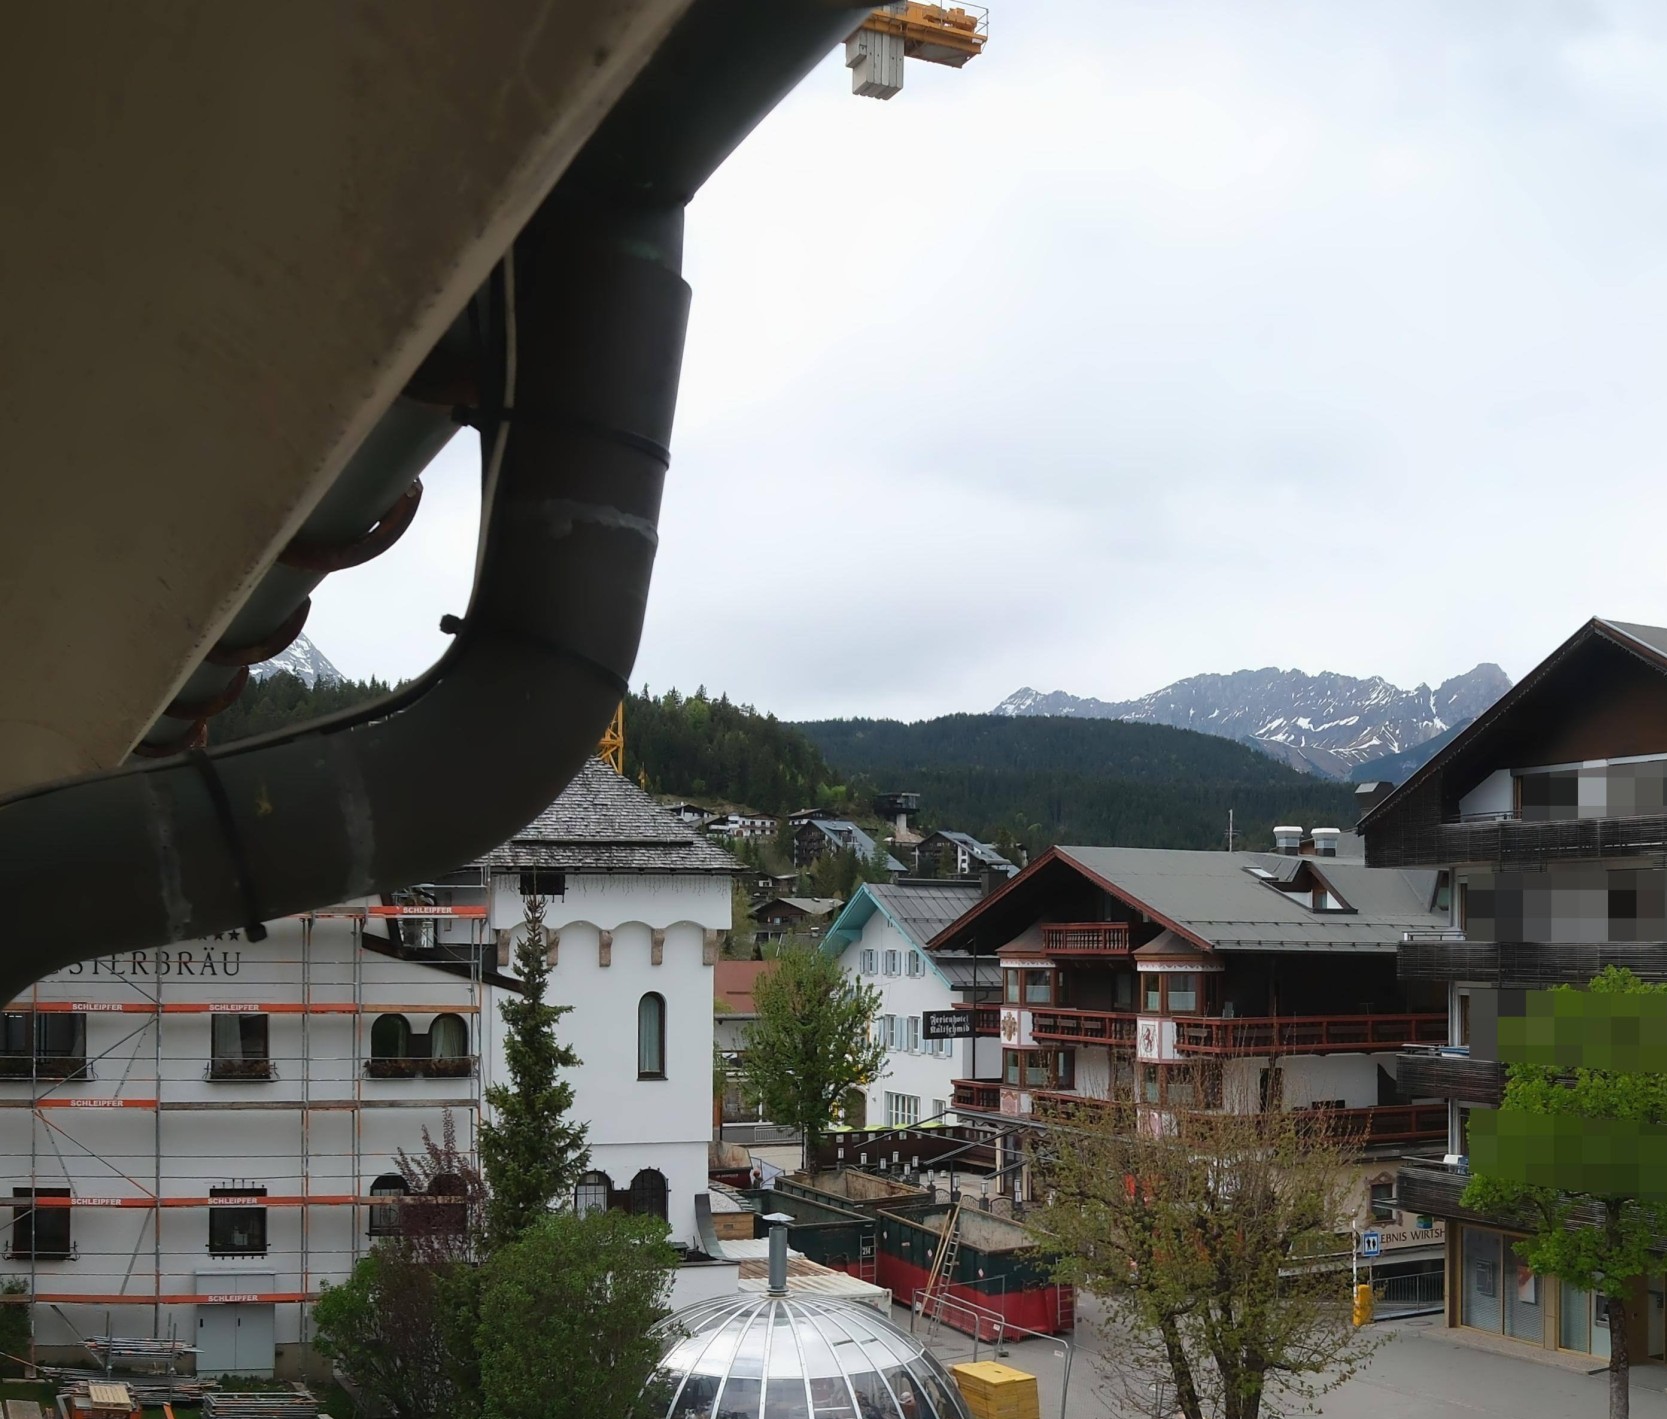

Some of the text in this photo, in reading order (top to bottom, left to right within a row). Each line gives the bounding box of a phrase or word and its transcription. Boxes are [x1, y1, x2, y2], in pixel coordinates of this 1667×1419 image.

[403, 906, 453, 914] SCHLEIPFER
[72, 1003, 123, 1011] SCHLEIPFER
[209, 1003, 260, 1011] SCHLEIPFER
[70, 1099, 123, 1107] SCHLEIPFER
[71, 1198, 122, 1206] SCHLEIPFER
[208, 1197, 258, 1205] SCHLEIPFER
[208, 1294, 258, 1302] SCHLEIPFER
